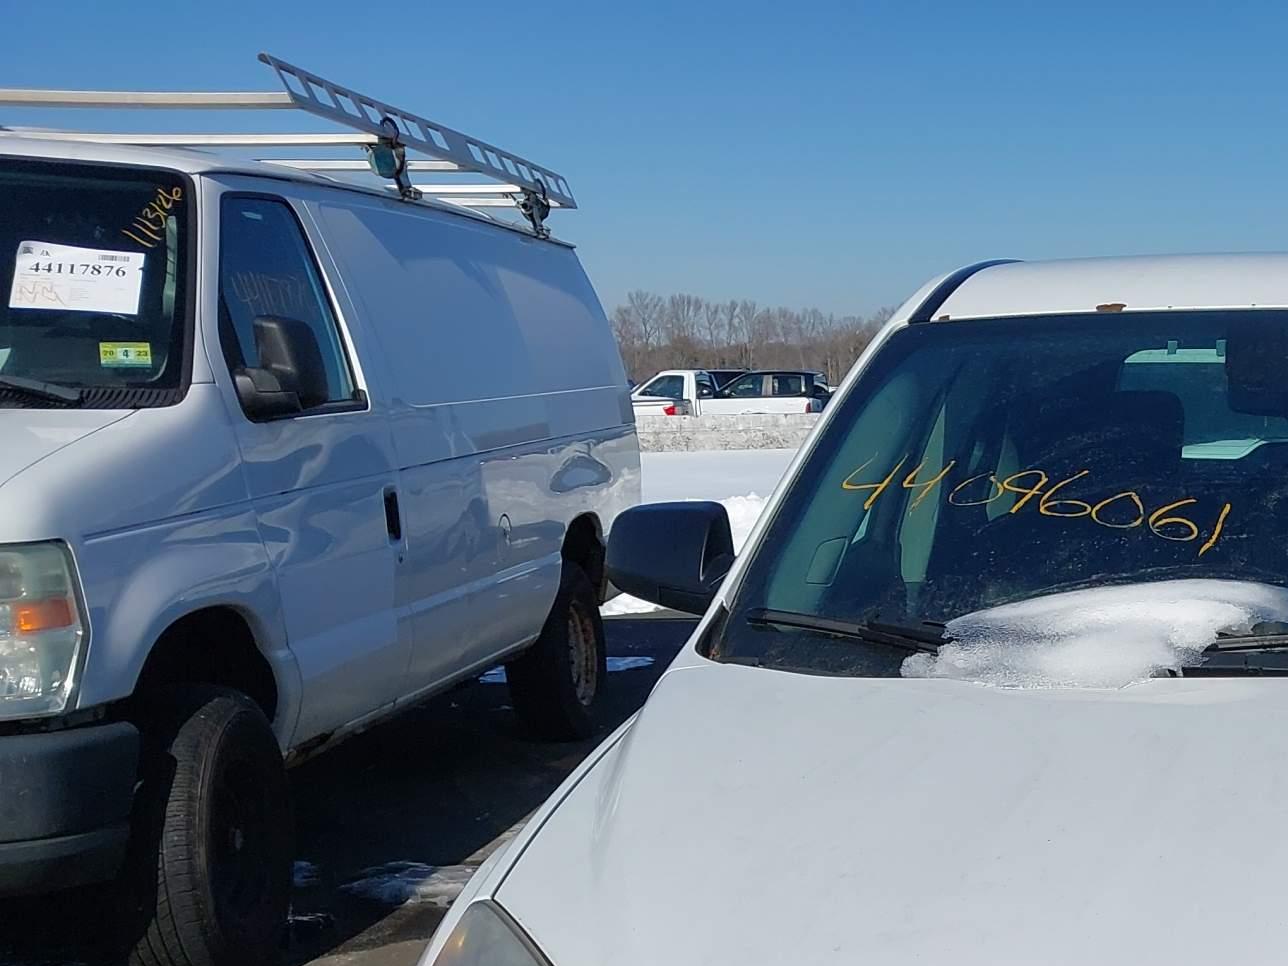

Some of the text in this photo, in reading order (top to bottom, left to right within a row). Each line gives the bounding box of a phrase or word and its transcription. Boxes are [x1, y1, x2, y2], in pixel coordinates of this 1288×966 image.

[29, 261, 127, 278] 44117876
[122, 349, 129, 359] 4
[840, 452, 1232, 557] 44096061
